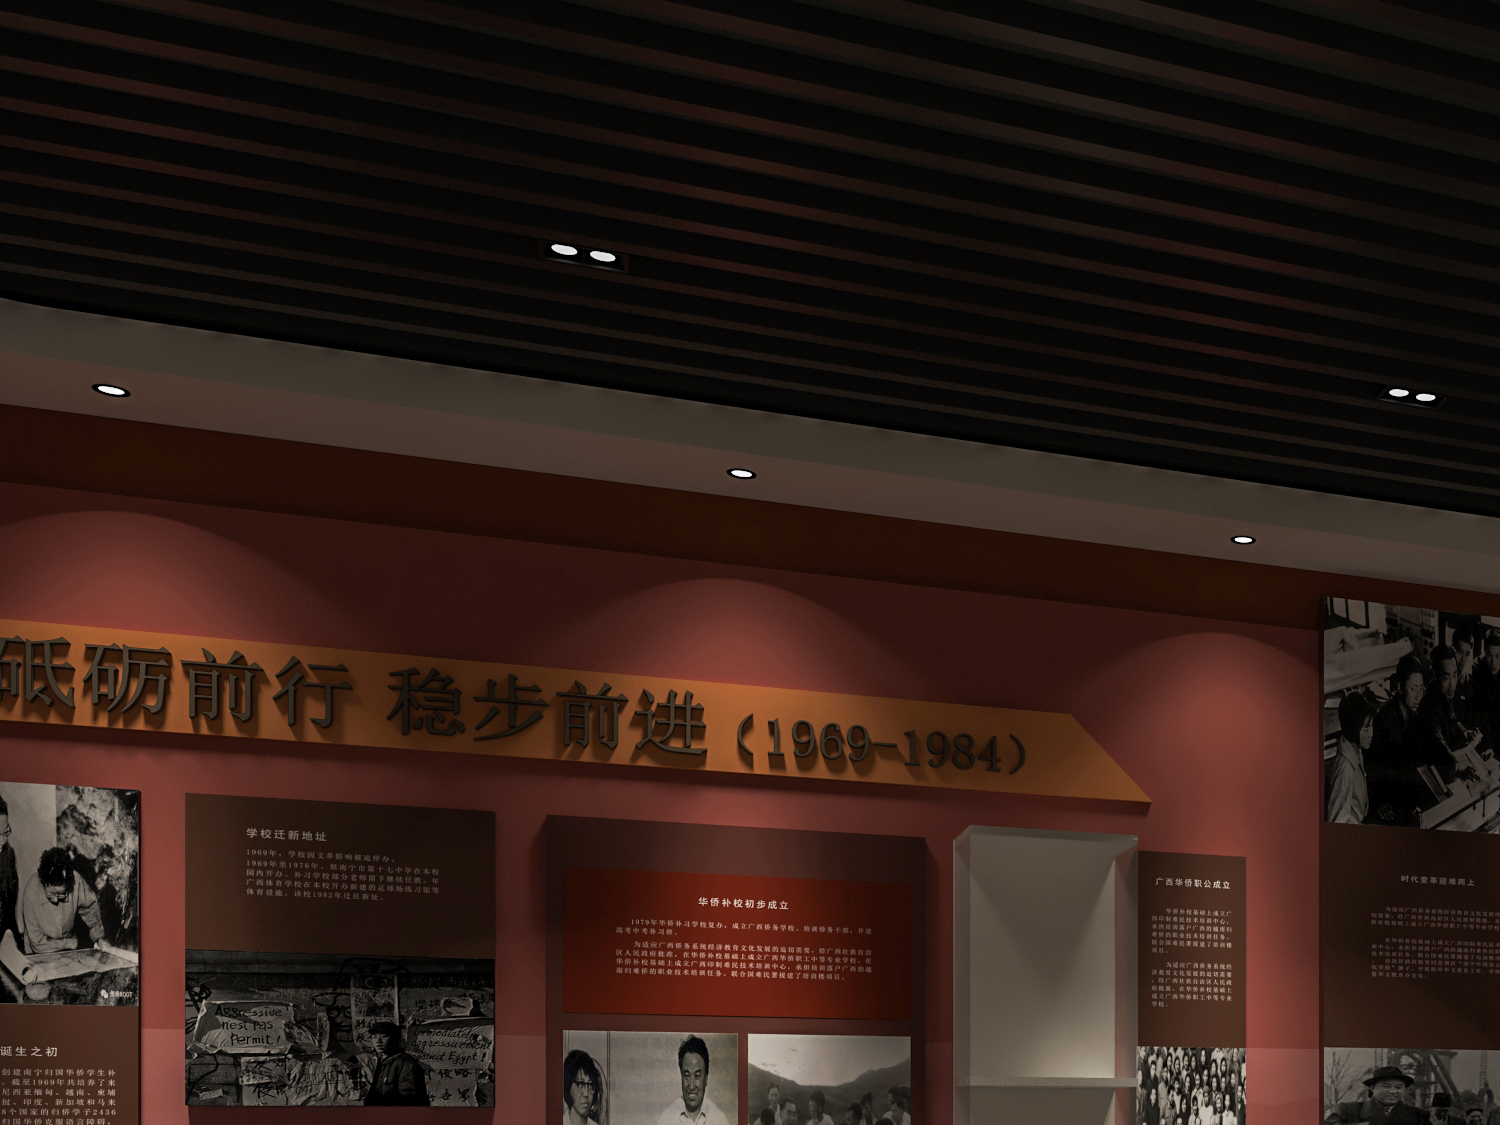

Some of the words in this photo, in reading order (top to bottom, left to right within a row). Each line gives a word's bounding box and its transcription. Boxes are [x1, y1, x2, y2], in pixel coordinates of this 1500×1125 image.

[0, 636, 353, 728] 砥砺前行
[387, 667, 707, 756] 稳步前进
[246, 827, 327, 842] 学校迁新地址
[698, 896, 789, 911] 华侨补校初步成立
[214, 1004, 282, 1018] Aggressive
[0, 1046, 58, 1058] 诞生之初
